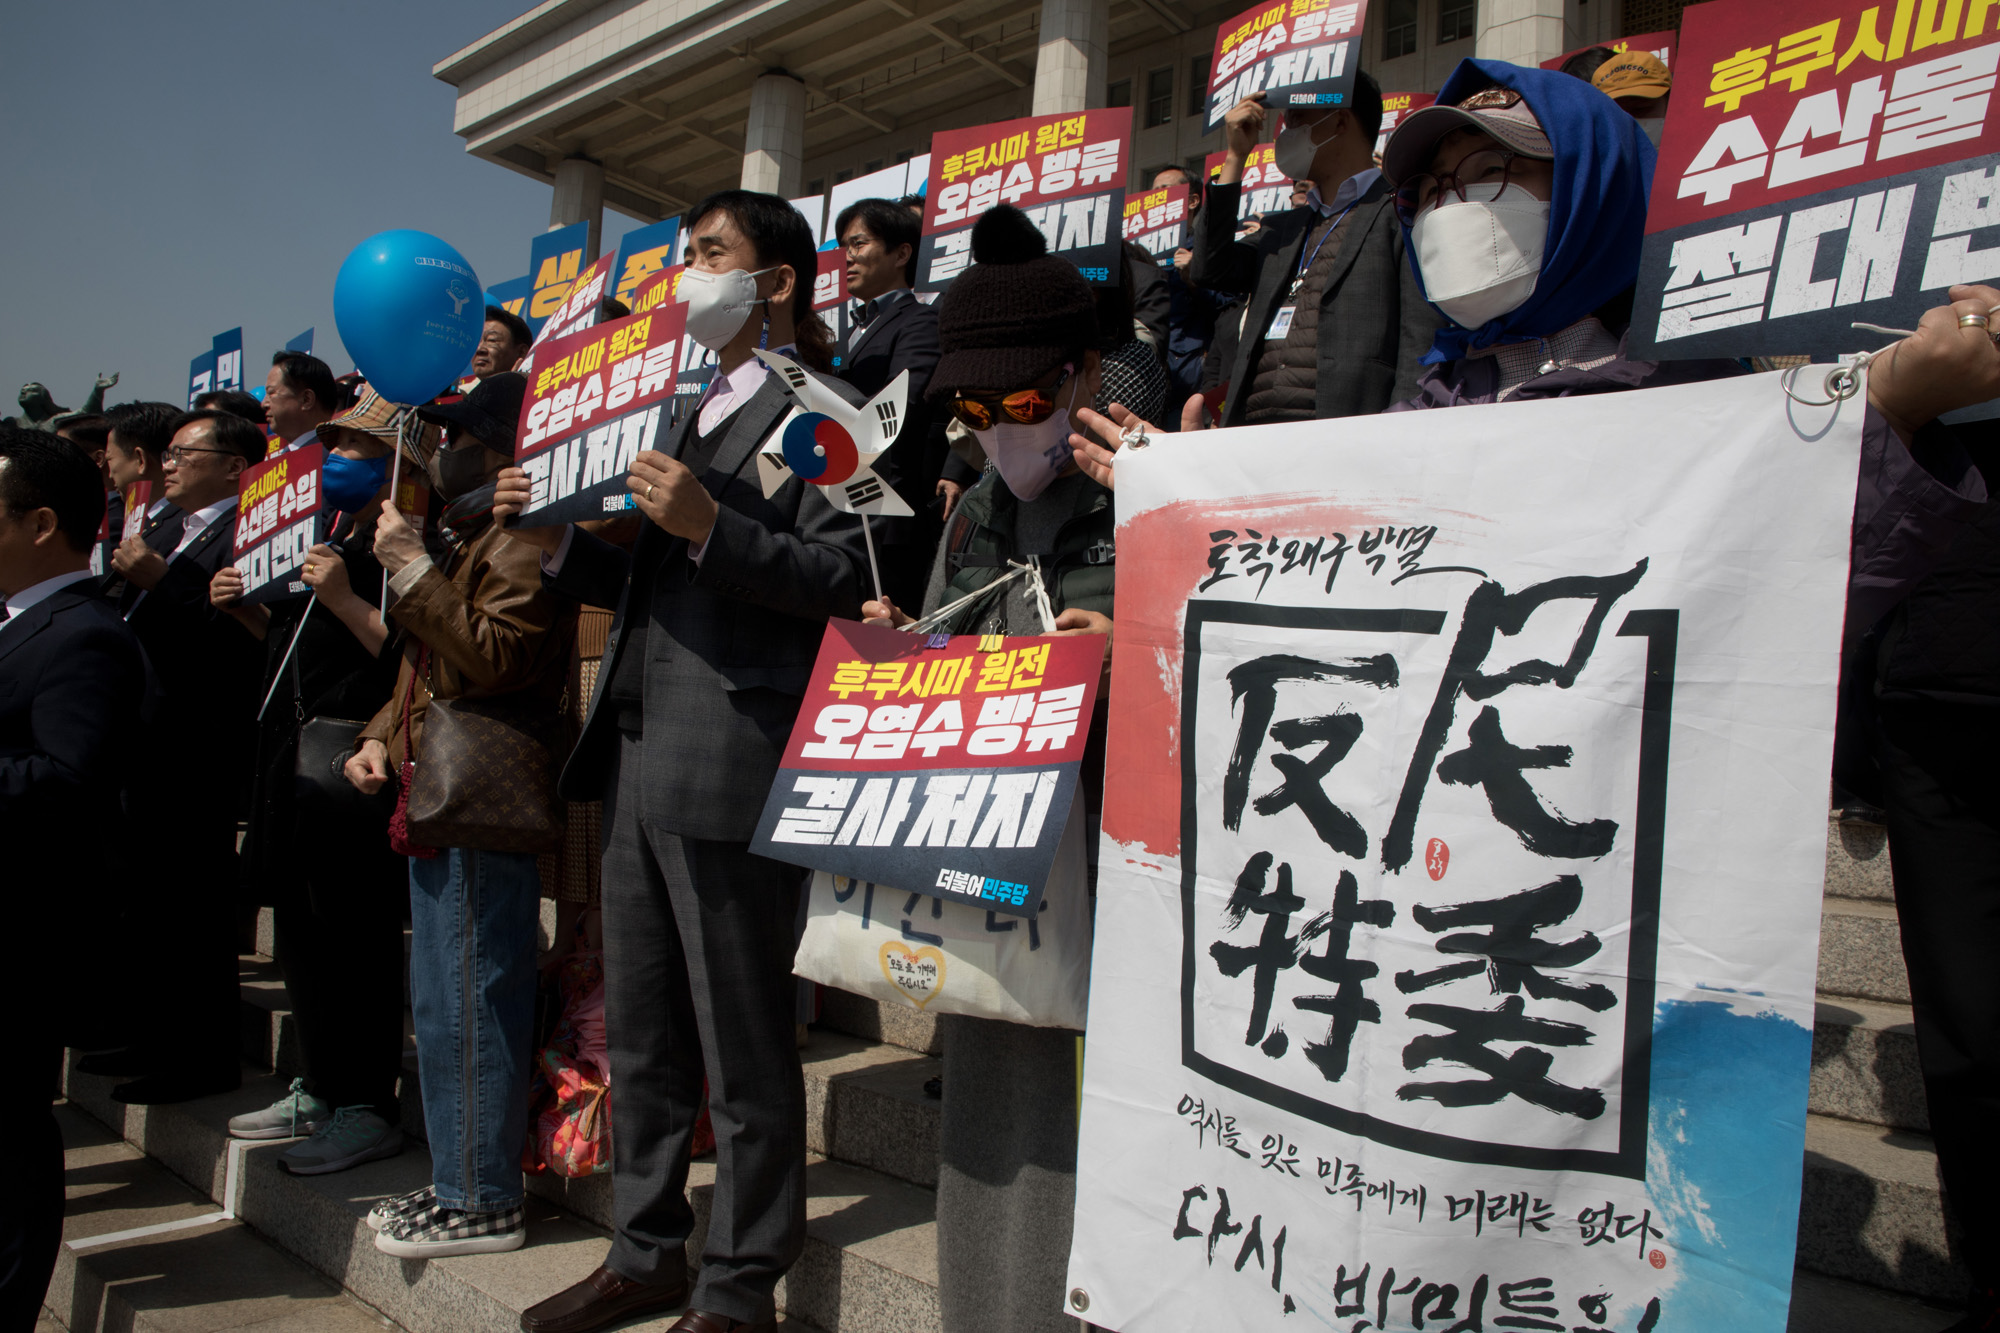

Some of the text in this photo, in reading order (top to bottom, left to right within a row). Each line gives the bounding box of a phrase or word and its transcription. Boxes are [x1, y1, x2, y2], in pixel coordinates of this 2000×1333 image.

[1213, 3, 1359, 87] 오염수 방류
[1220, 3, 1286, 54] 후쿠시마
[1265, 41, 1349, 90] 저지
[1289, 93, 1343, 104] 더불어민주당
[941, 115, 1086, 183] 후쿠시마 원전
[1677, 42, 2000, 206] 수산물
[933, 138, 1121, 227] 오염수 방류
[1144, 190, 1168, 210] 원전
[1147, 198, 1184, 228] 방류
[530, 248, 582, 318] 생
[567, 270, 606, 320] 방류
[572, 263, 597, 296] 원전
[1654, 183, 1917, 343] 절대
[534, 338, 605, 399] 후쿠시마
[607, 316, 652, 364] 원전
[522, 372, 603, 450] 오염수
[605, 339, 677, 410] 방류
[240, 459, 288, 514] 후쿠시마산
[519, 405, 662, 517] 결사 저지
[235, 469, 317, 549] 수산물 수입
[272, 516, 315, 580] 반대
[828, 643, 1051, 701] 후쿠시마 원전
[800, 683, 1087, 760] 오염수 방류
[770, 770, 1060, 848] 결사 저지
[935, 868, 1029, 906] 더불어민주당
[1177, 1093, 1251, 1159] 역사를
[1261, 1134, 1300, 1177] 잊은
[1317, 1156, 1427, 1223] 민족에게
[1444, 1189, 1555, 1238] 미래는
